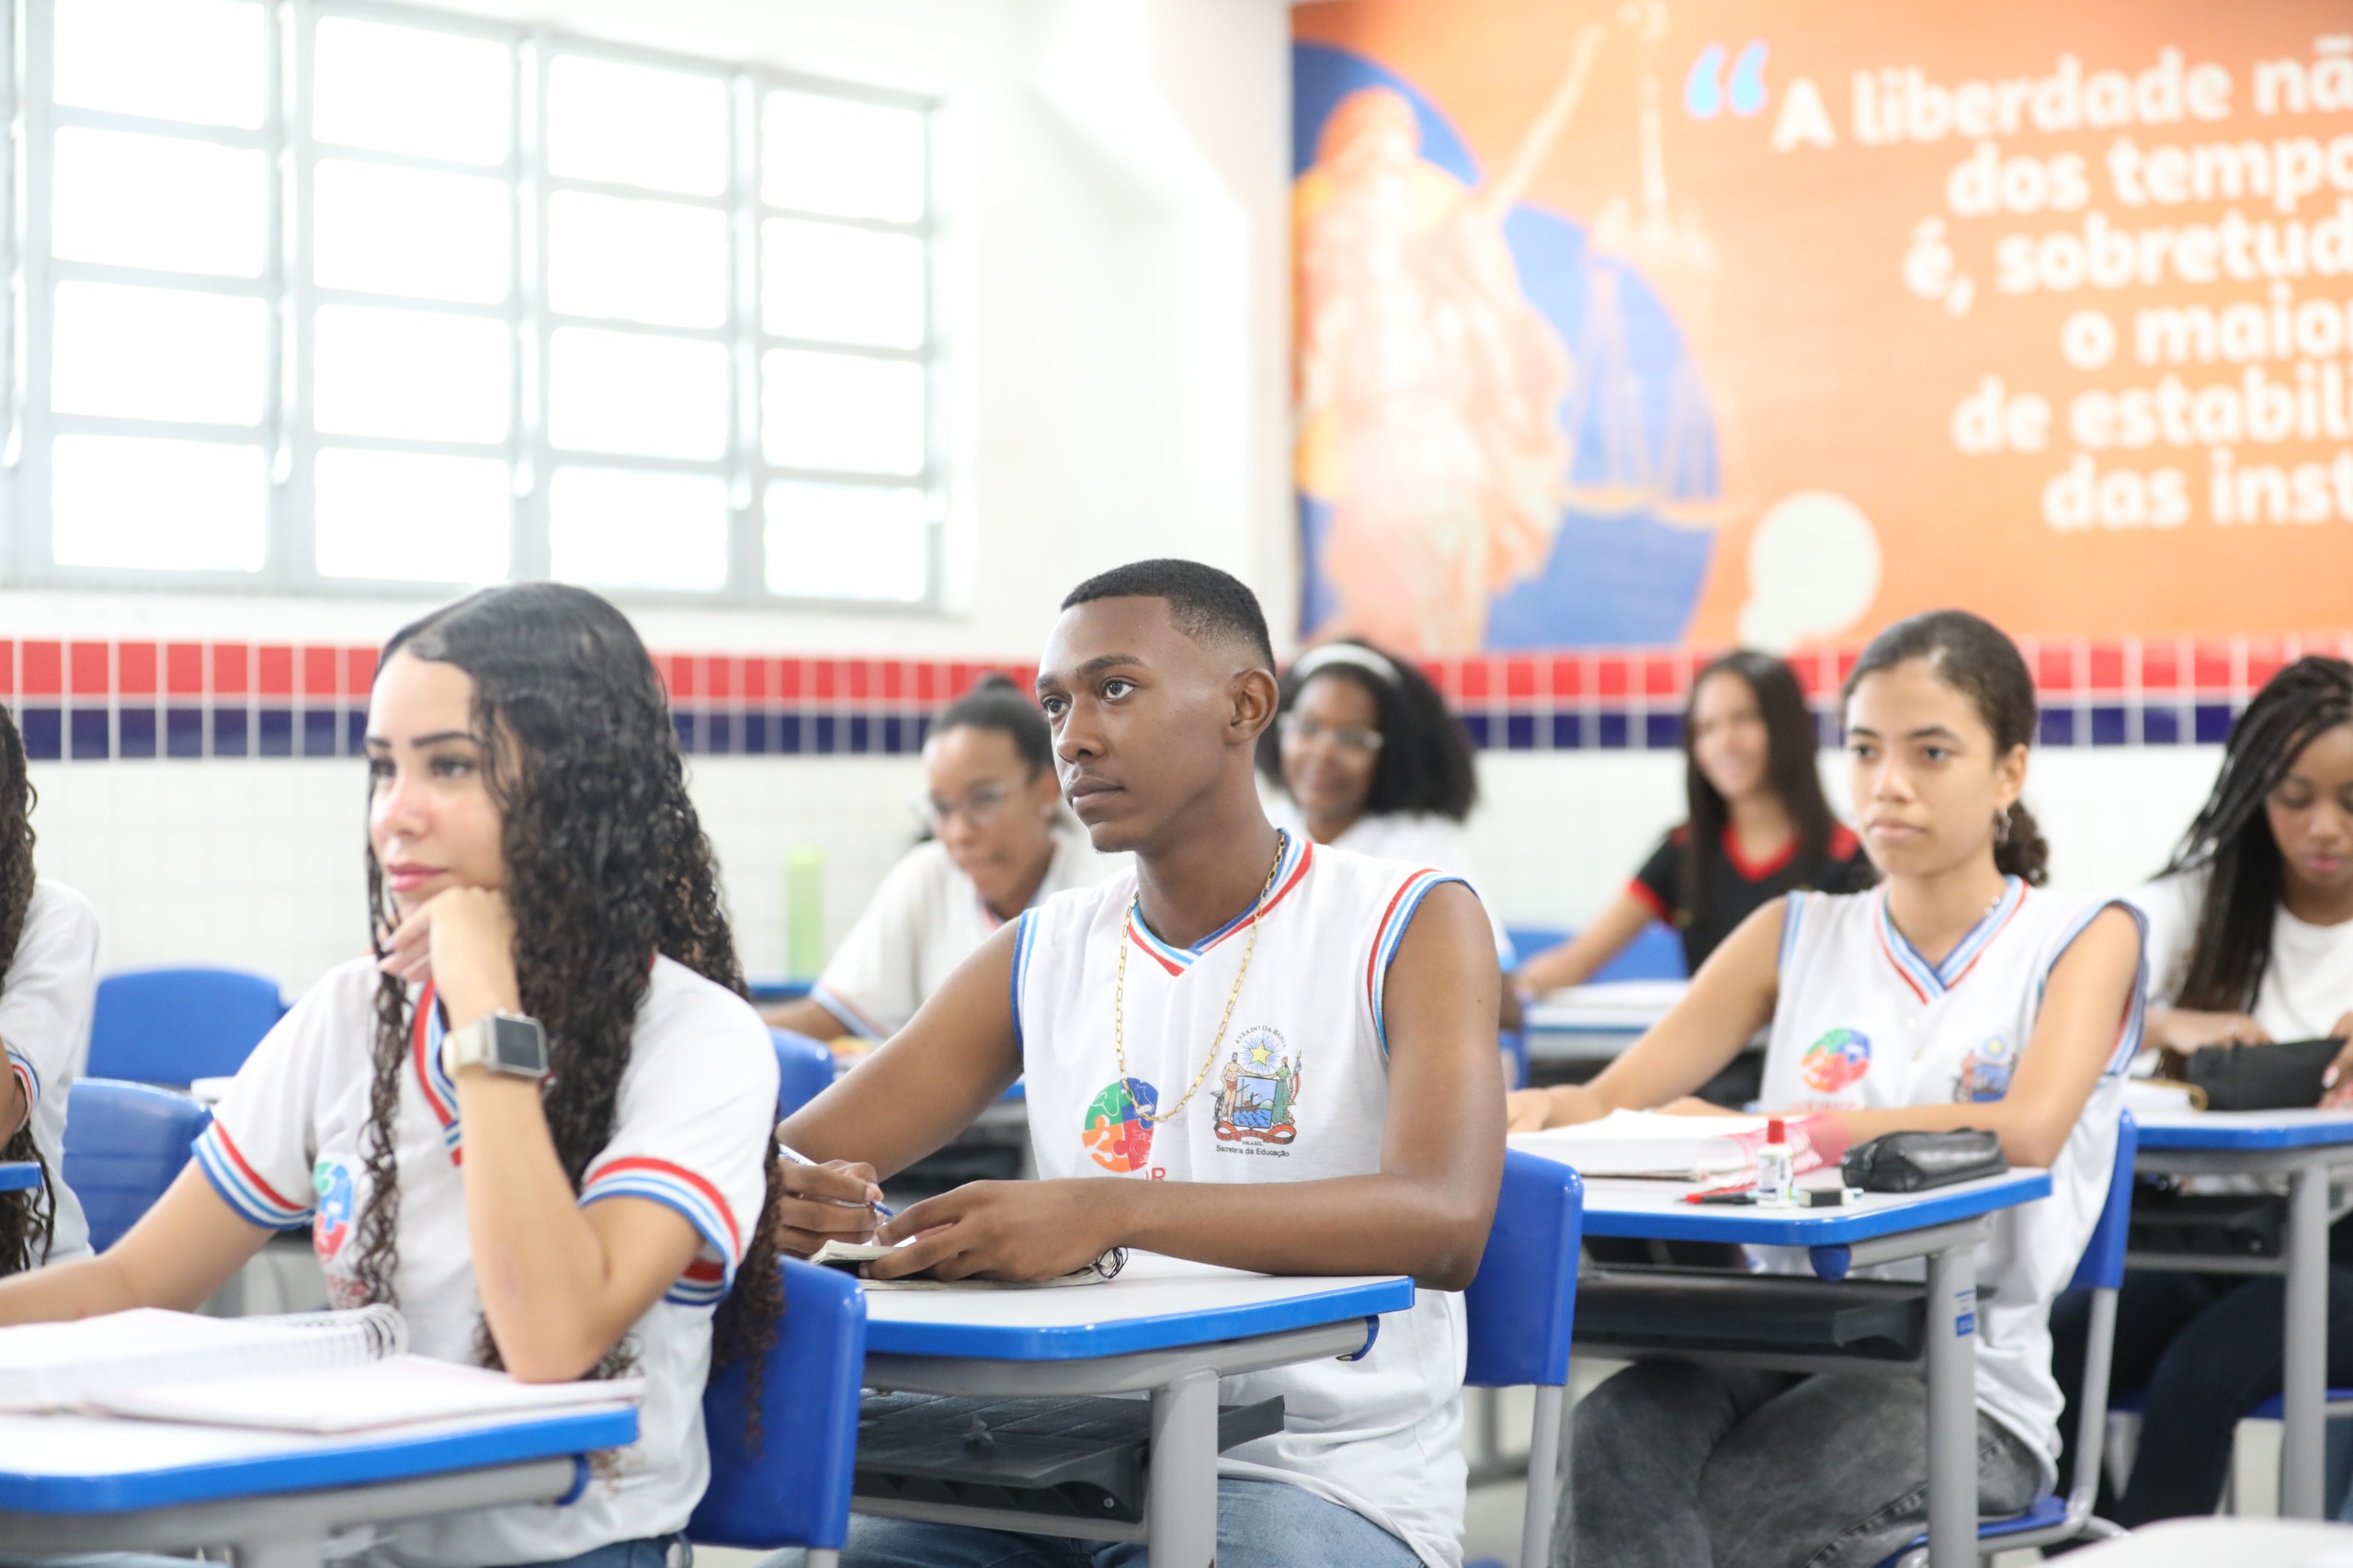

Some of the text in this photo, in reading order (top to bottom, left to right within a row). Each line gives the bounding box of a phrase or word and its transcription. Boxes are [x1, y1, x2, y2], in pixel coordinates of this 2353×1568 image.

[1772, 79, 1835, 151] A
[1851, 48, 2232, 145] liberdade
[1947, 140, 2091, 217] dos
[1904, 197, 2353, 315] é, sobretud
[2062, 278, 2353, 369] o maio
[1951, 361, 2353, 454] de estabil
[2042, 450, 2190, 530] das
[1234, 1025, 1261, 1045] ESTADO
[1262, 1025, 1272, 1034] DA
[1216, 1144, 1290, 1158] Secretaria da Educação
